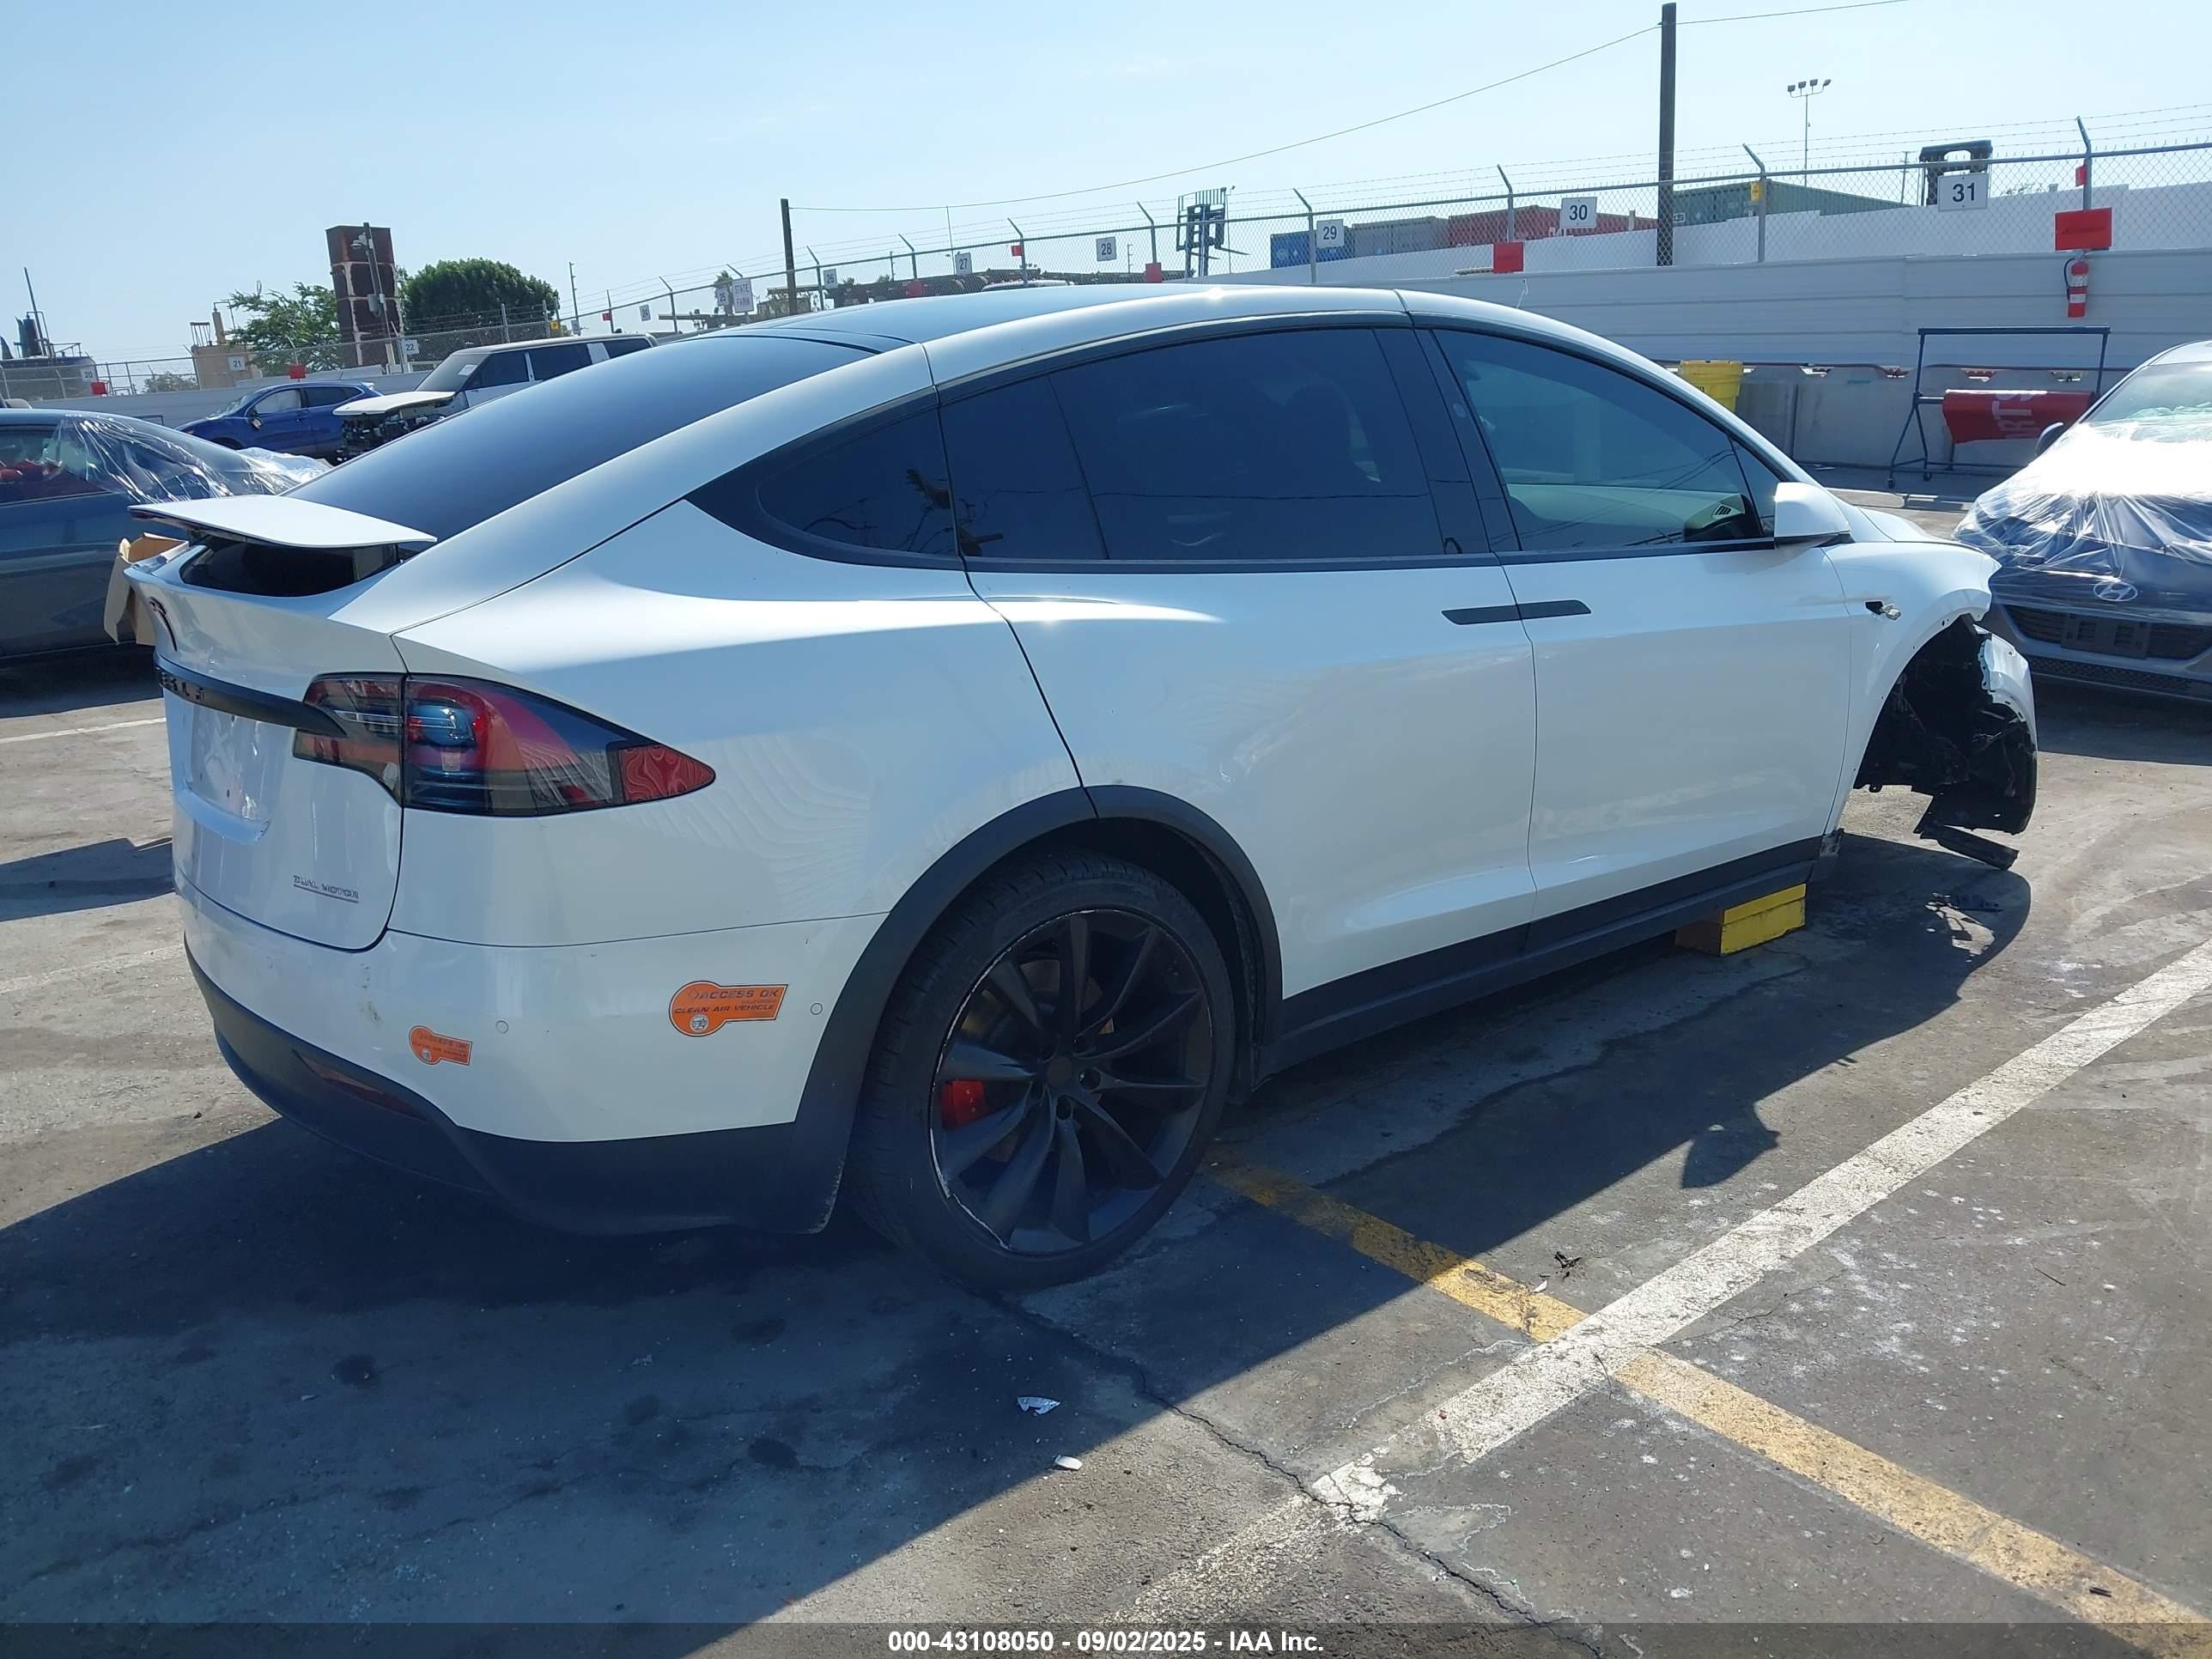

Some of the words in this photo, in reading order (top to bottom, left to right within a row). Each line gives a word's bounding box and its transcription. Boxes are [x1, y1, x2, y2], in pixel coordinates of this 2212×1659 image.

[1952, 182, 1976, 203] 31
[1569, 204, 1588, 221] 30
[1322, 226, 1338, 240] 29
[1100, 244, 1112, 256] 28
[958, 258, 969, 270] 27
[826, 273, 835, 284] 26
[734, 283, 750, 294] STATE
[736, 296, 750, 307] FARM
[405, 343, 415, 351] 22
[233, 359, 242, 368] 21
[293, 875, 319, 890] DUAL
[321, 883, 359, 899] MOTOR
[699, 989, 754, 1000] ACCESS
[759, 989, 778, 998] OK
[734, 1003, 774, 1012] VEHICLE
